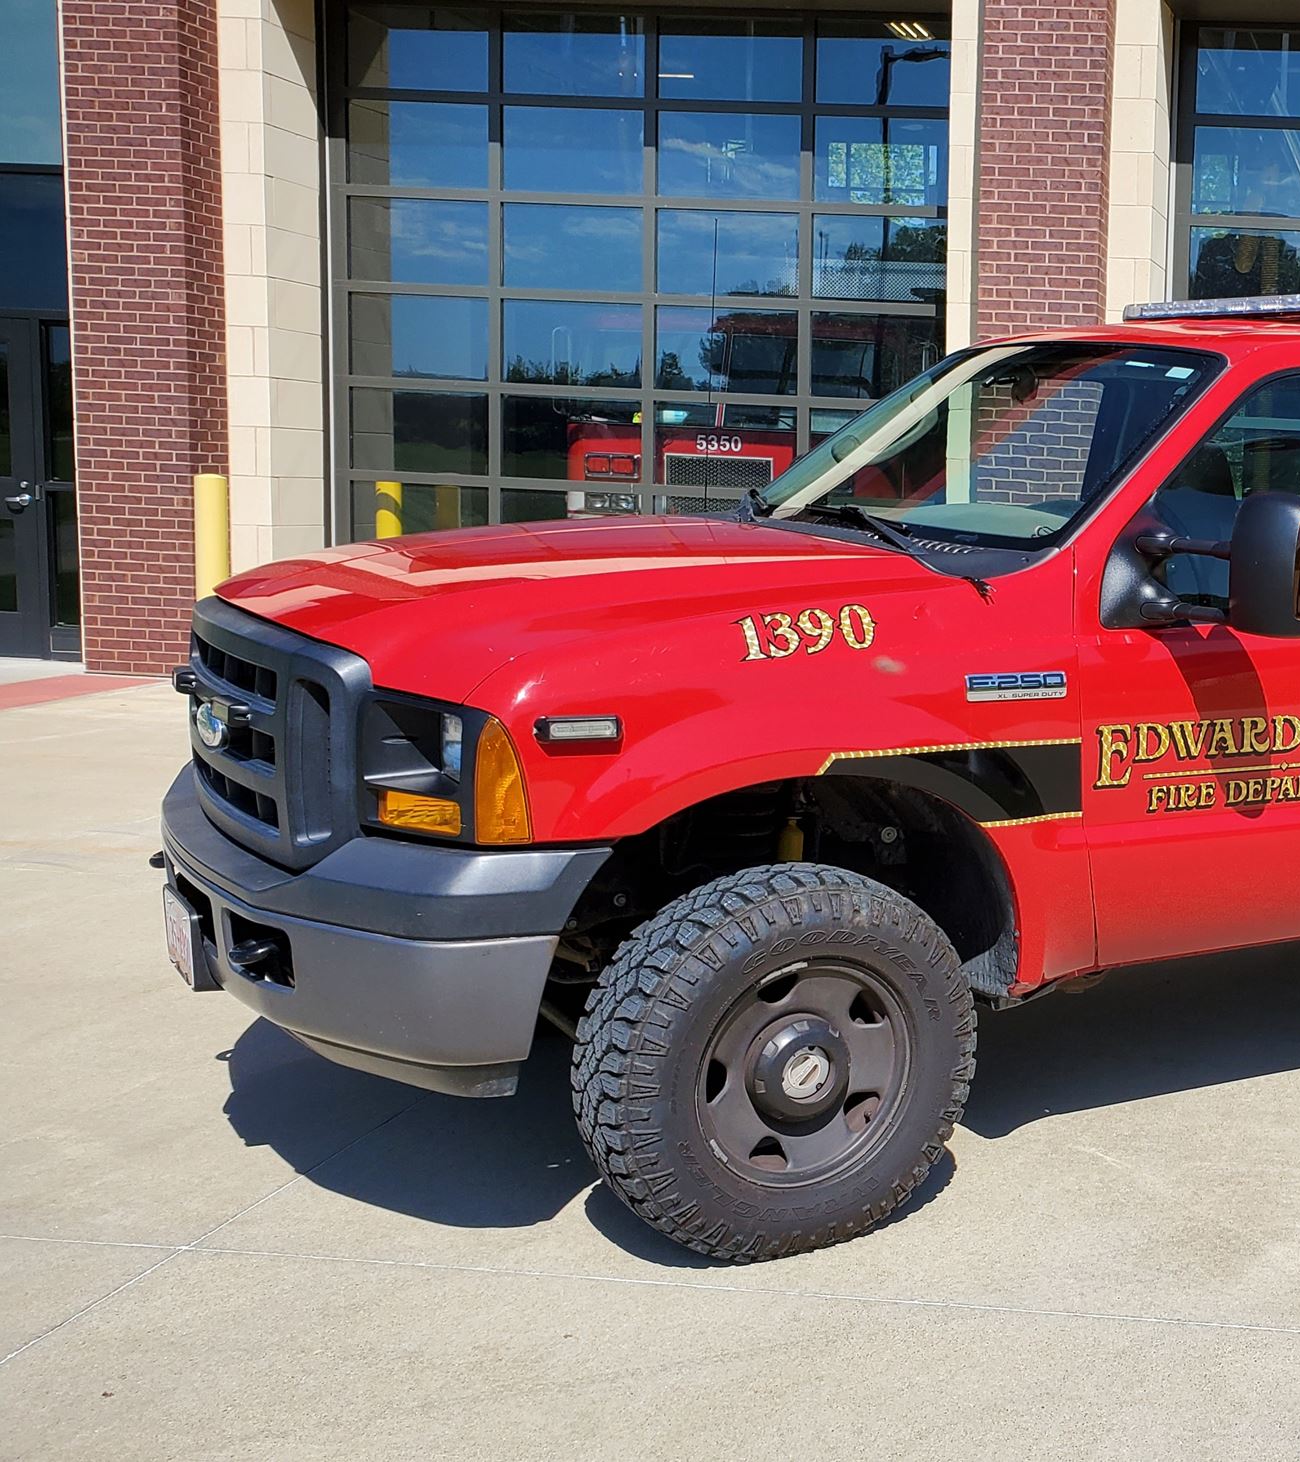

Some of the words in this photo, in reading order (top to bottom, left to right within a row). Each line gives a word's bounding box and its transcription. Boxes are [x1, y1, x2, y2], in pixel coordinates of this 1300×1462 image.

[696, 434, 742, 452] 5350
[733, 604, 877, 662] 1390
[967, 673, 1066, 692] F-250
[1146, 782, 1216, 813] FIRE
[743, 930, 942, 1022] GOODYEAR
